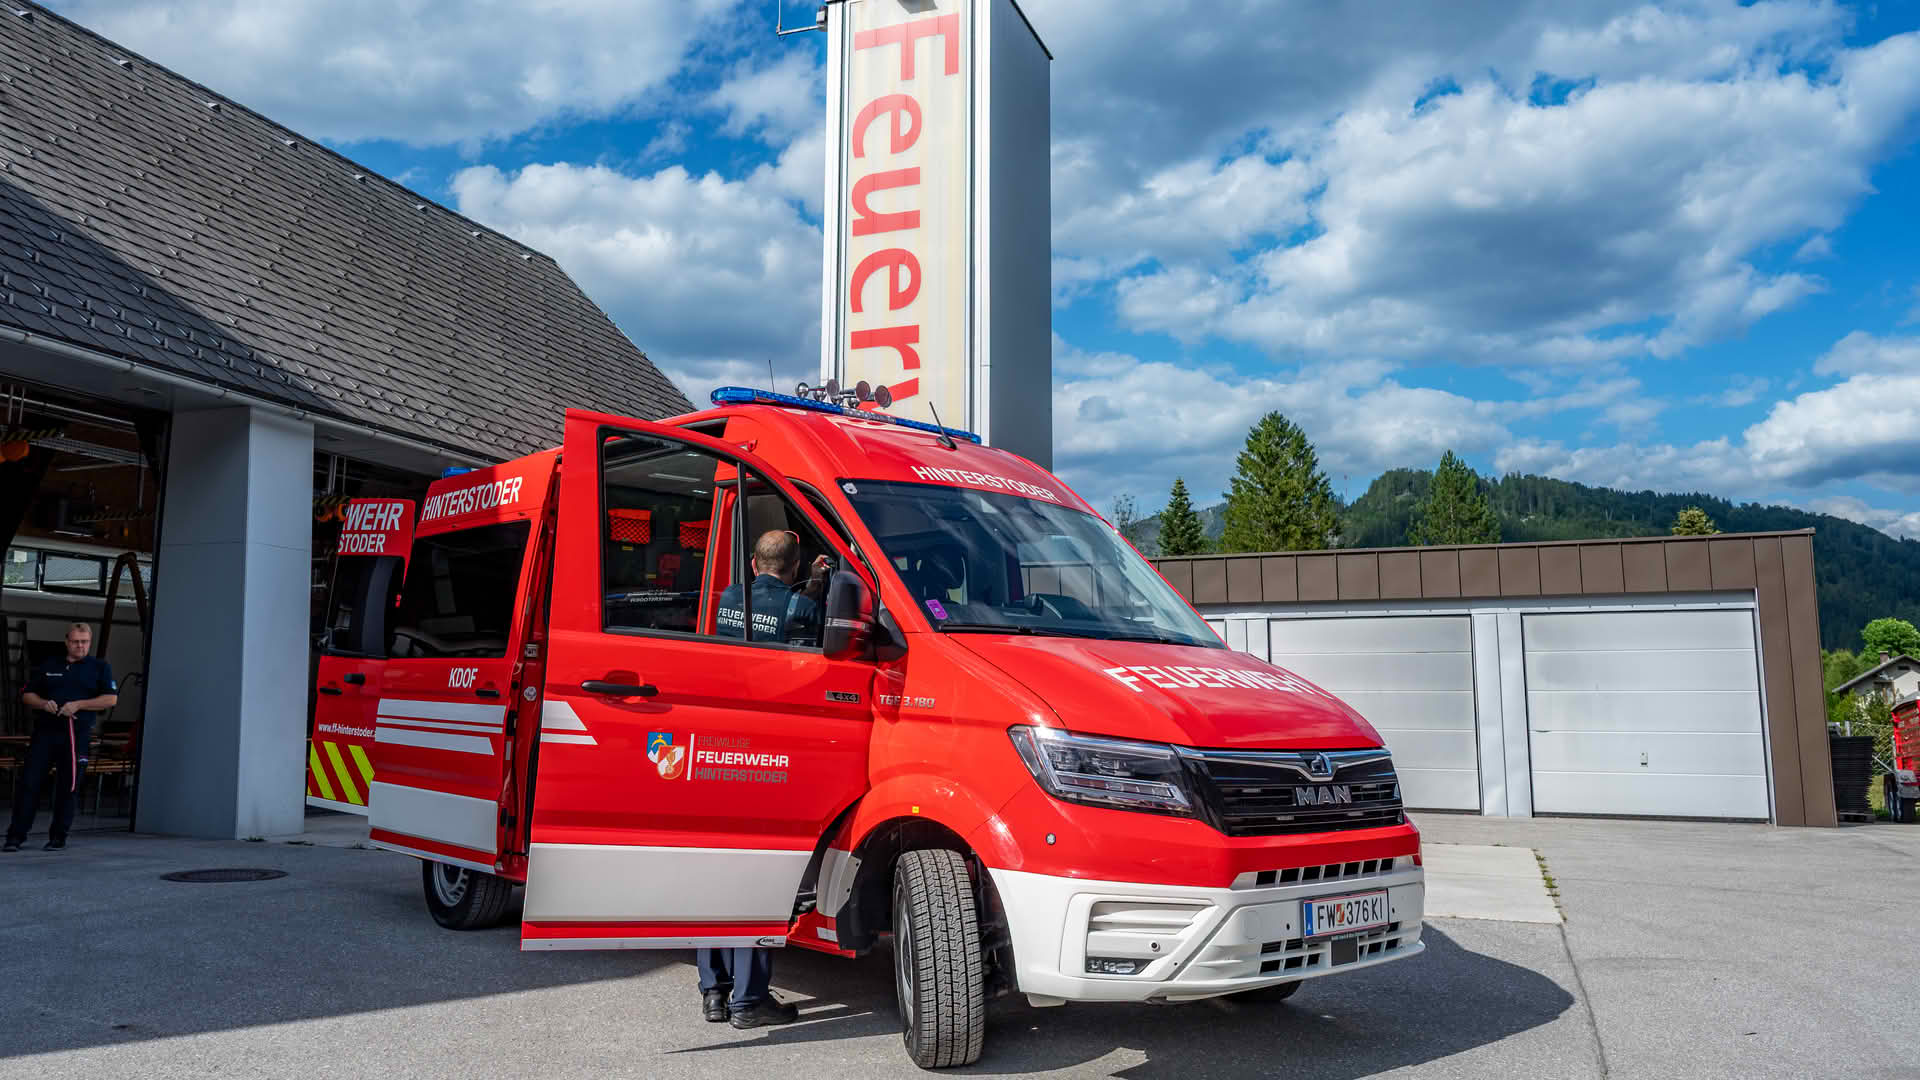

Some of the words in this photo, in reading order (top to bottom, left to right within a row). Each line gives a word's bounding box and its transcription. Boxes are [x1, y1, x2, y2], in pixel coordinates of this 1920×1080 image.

[911, 465, 1062, 503] HINTERSTODER
[422, 476, 522, 521] HINTERSTODER
[342, 503, 404, 531] WEHR
[448, 667, 478, 688] KDOF
[903, 696, 936, 709] 3.180
[696, 750, 789, 768] FEUERWEHR
[695, 767, 788, 784] HINTERSTODER
[1295, 785, 1352, 806] MAN
